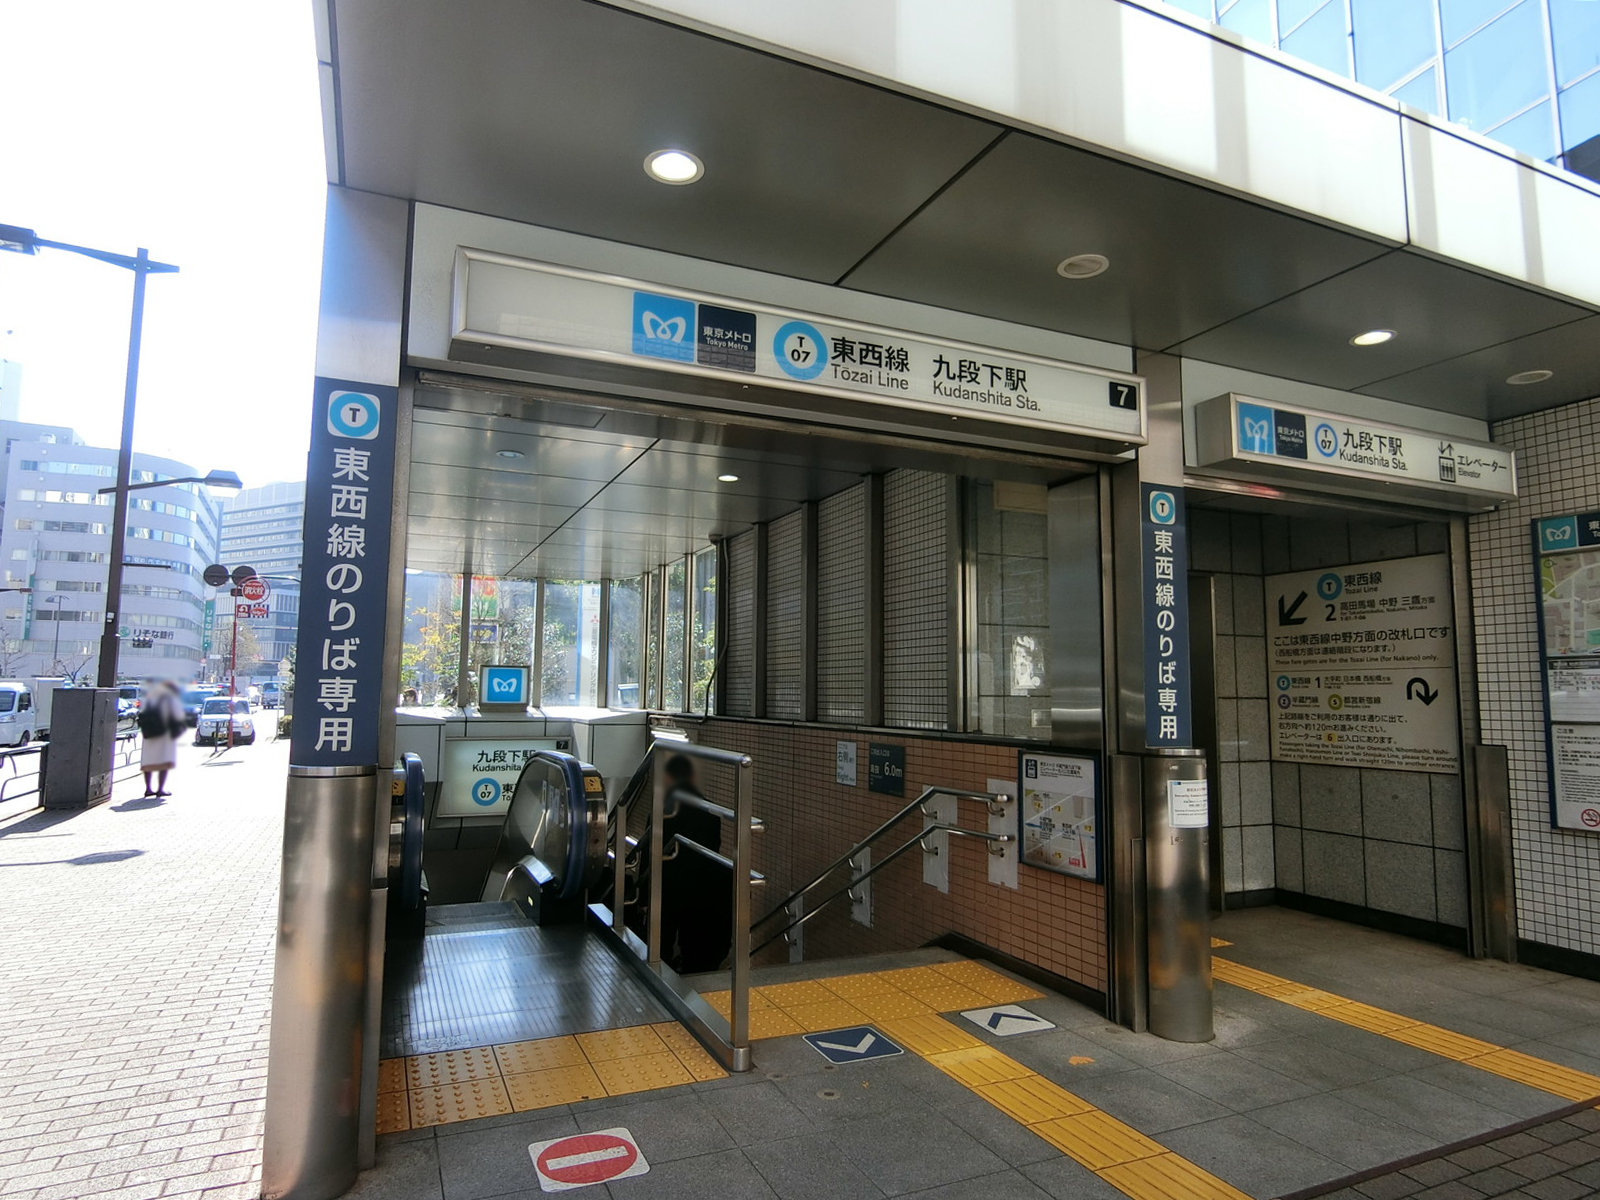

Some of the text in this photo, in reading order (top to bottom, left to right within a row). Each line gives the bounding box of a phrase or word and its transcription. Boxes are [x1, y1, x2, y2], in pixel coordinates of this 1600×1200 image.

[703, 326, 751, 343] 東京メトロ
[706, 337, 749, 352] Tokyo Metro
[797, 336, 805, 348] T
[791, 349, 811, 363] 07
[830, 336, 1028, 394] 東西線 九段下駅
[831, 364, 1042, 412] Tōzai Line Kudanshita Sta.
[1117, 386, 1130, 406] 7
[348, 407, 361, 422] T
[1276, 424, 1306, 438] 東京メトロ
[1323, 429, 1329, 438] T
[1321, 439, 1333, 450] 07
[1342, 428, 1403, 457] 九段下駅
[1339, 449, 1409, 471] Kudanshita Sta.
[1457, 454, 1508, 474] エレベーター
[1457, 467, 1482, 479] Elevator
[1159, 503, 1167, 514] T
[1344, 571, 1383, 587] 東西線
[1326, 582, 1333, 592] T
[314, 446, 371, 753] 東西線のりば専用
[1340, 599, 1376, 611] 高田馬場
[1379, 597, 1398, 608] 中野
[1325, 604, 1336, 621] 2
[133, 628, 174, 640] りそな銀行
[1154, 529, 1178, 741] 東西線のりば専用
[1274, 626, 1451, 647] ここは東西線中野方面の改札口です
[1393, 654, 1420, 662] Nakano)
[1291, 676, 1311, 685] 東西線
[1315, 676, 1321, 689] 1
[1292, 696, 1319, 704] 半蔵門線
[1344, 696, 1381, 704] 都営新宿線
[1278, 712, 1408, 724] 上記路線をご利用のお客様は通りに出て、
[1278, 721, 1387, 733] 右方向へ約120mお進みください。
[1279, 731, 1397, 745] エレベーターは 6 出入口にあります。
[472, 763, 522, 772] Kudanshita
[884, 761, 903, 778] 6.0m
[480, 791, 492, 799] 07
[502, 783, 517, 794] 東
